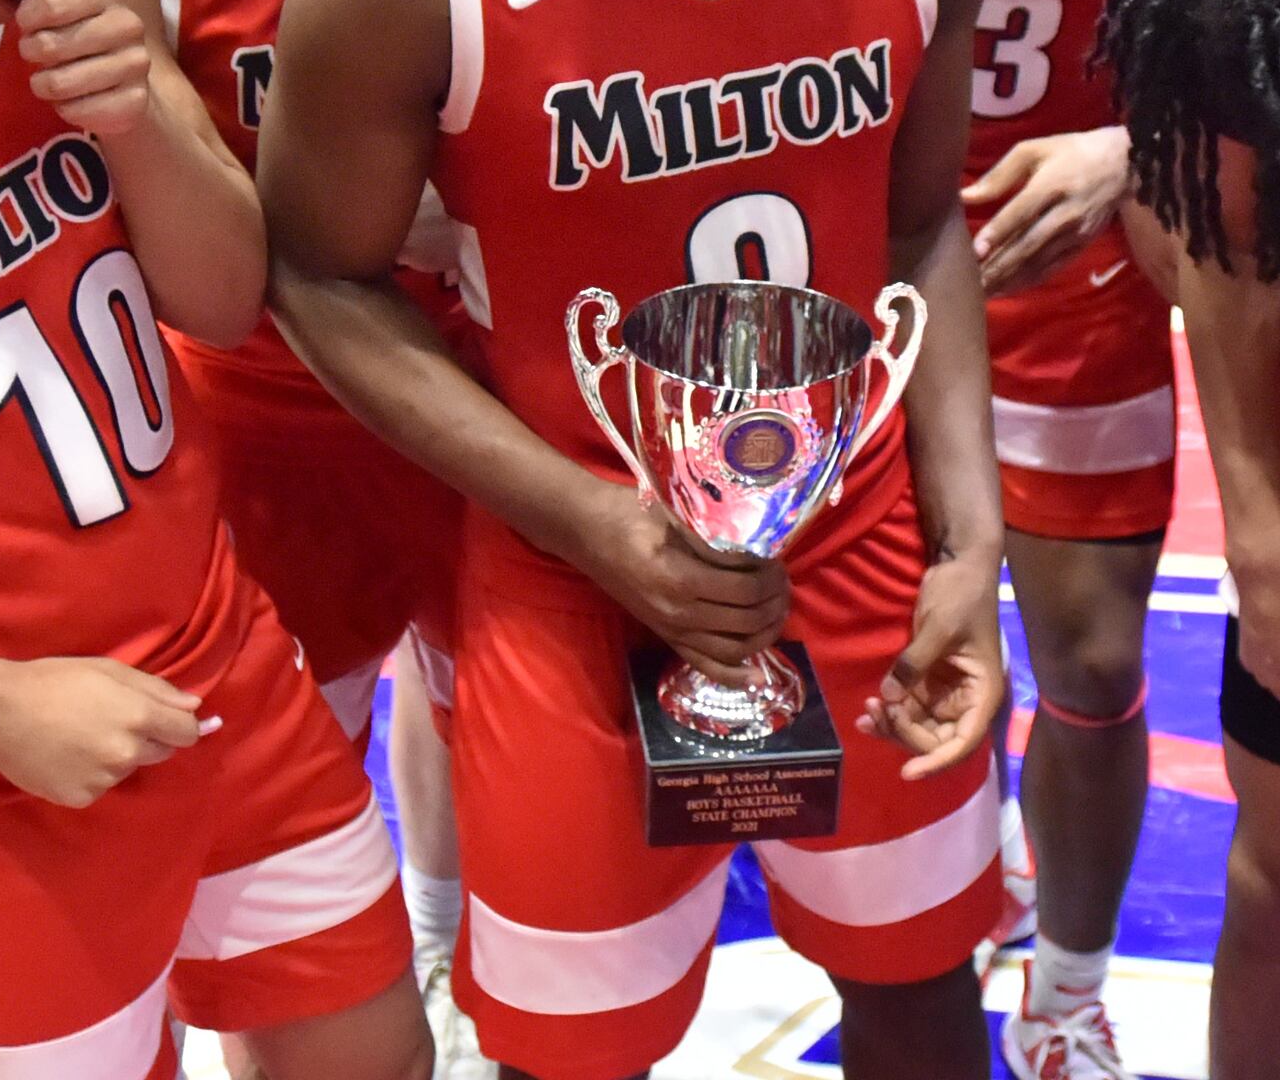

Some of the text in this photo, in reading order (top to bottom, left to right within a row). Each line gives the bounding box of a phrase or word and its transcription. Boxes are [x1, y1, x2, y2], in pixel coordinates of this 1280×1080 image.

[543, 38, 893, 191] MILTON
[657, 768, 835, 788] Georgia High School Association
[686, 793, 805, 811] BOYS BASKETBALL
[692, 806, 798, 823] STATE CHAMPION
